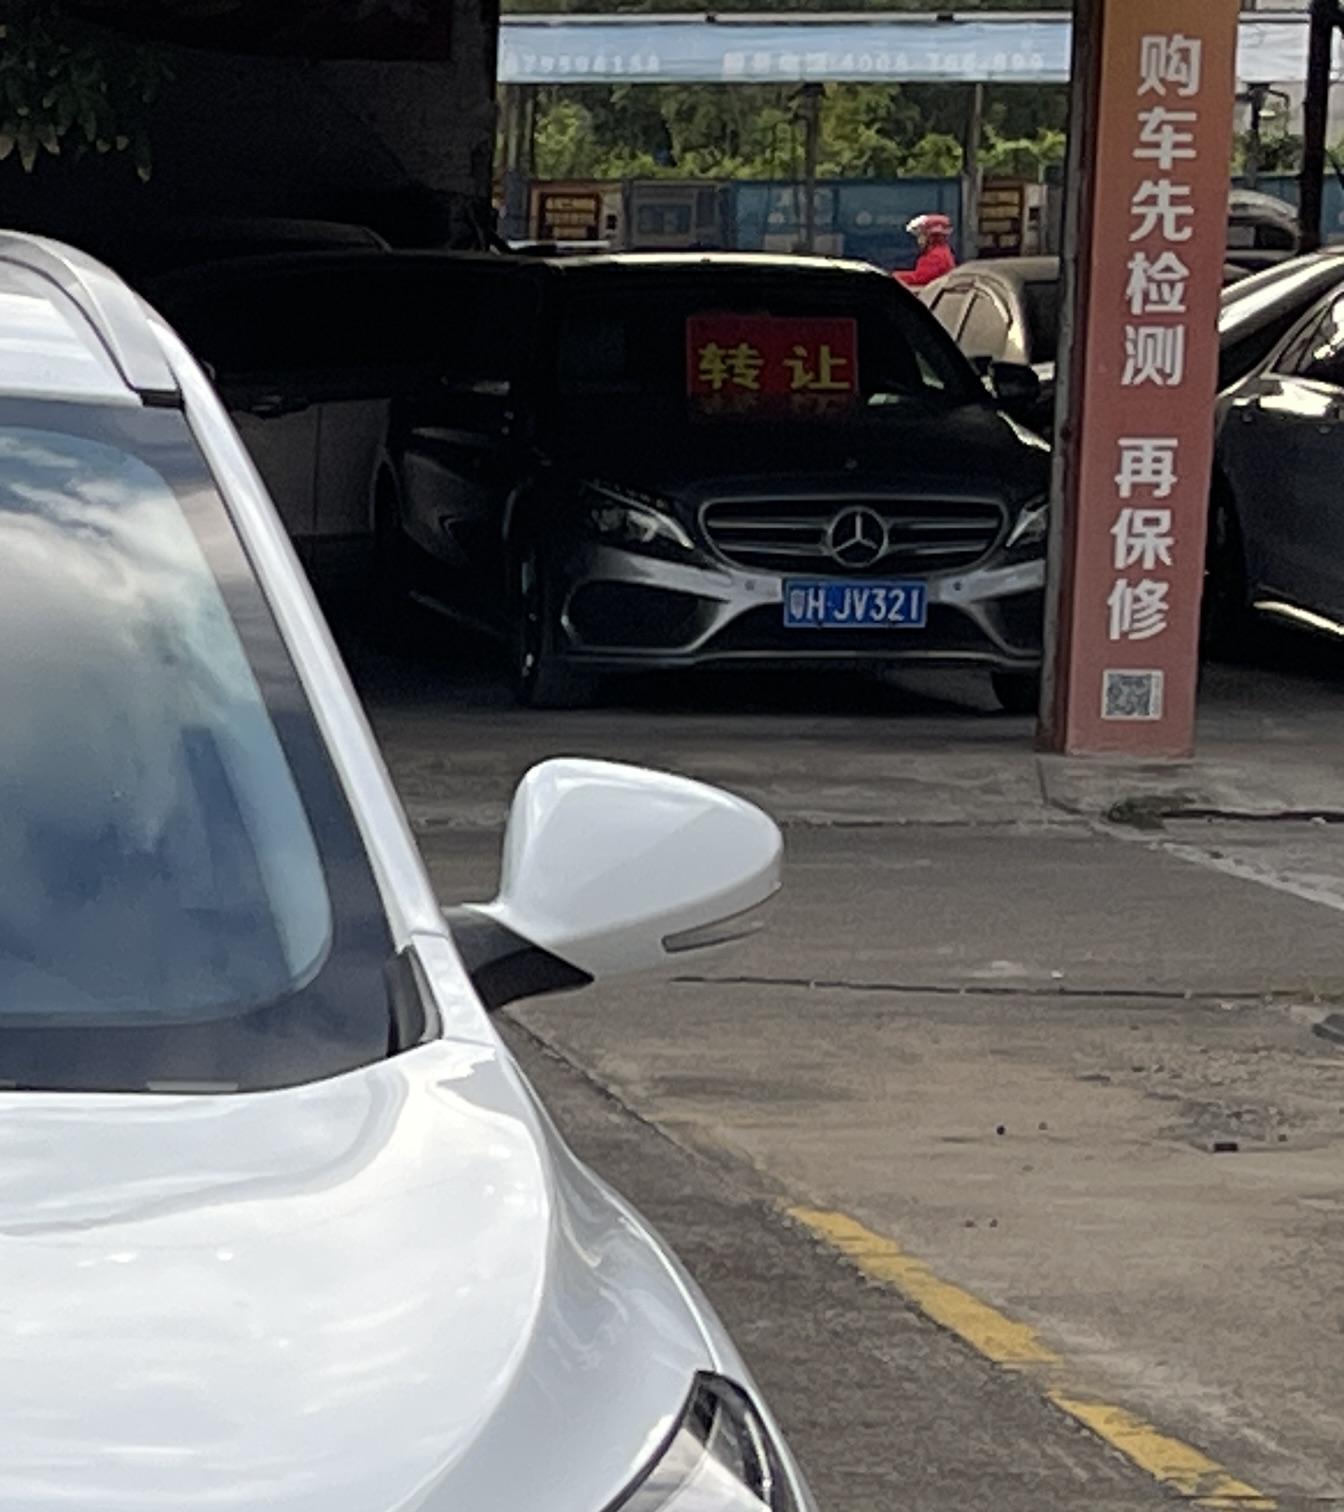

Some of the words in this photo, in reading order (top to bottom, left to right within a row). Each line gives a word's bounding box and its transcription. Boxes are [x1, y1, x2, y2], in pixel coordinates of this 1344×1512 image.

[1121, 34, 1203, 387] 购车先检测
[697, 341, 852, 391] 转让
[1107, 437, 1177, 640] 再保修
